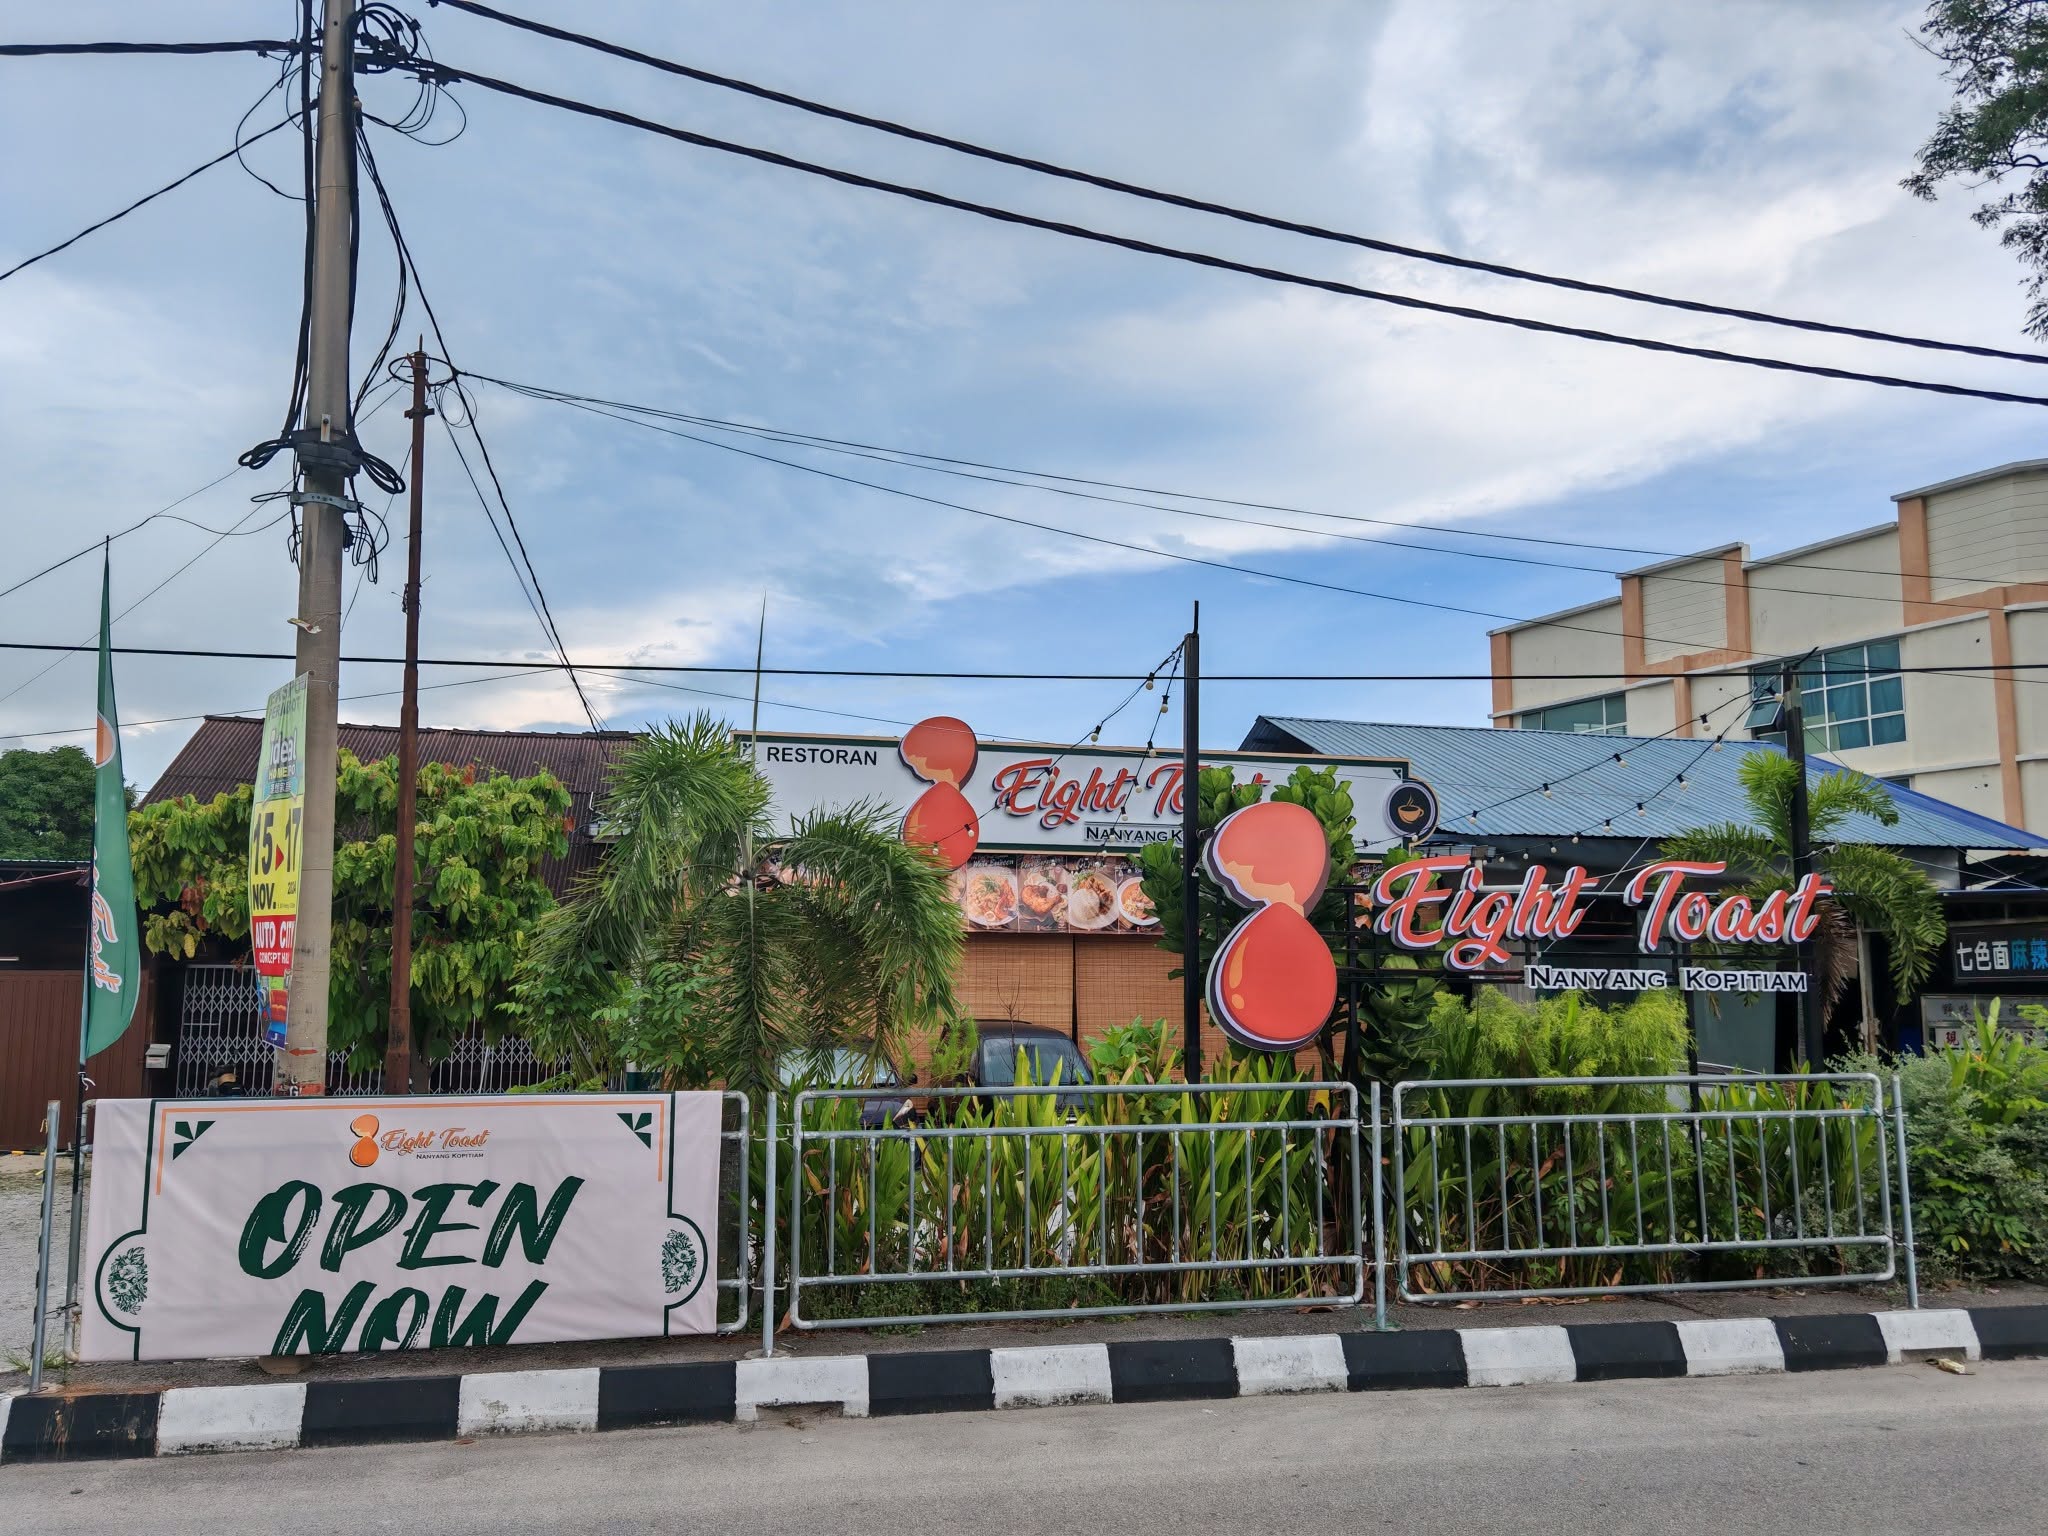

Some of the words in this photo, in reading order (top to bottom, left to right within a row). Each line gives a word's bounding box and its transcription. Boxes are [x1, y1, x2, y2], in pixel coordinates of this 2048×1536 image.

[767, 746, 877, 766] RESTORAN
[992, 758, 1138, 830] Eight
[254, 812, 274, 875] 15
[285, 808, 301, 873] 17
[1086, 826, 1168, 842] NANYANG
[252, 883, 276, 911] NOV.
[1369, 854, 1600, 971] Eight
[1623, 861, 1834, 954] Toast
[255, 921, 276, 949] AUTO
[1529, 966, 1666, 989] NANYANG
[1685, 969, 1806, 992] KOPITIAM
[380, 1129, 436, 1156] Eight
[439, 1127, 491, 1150] Toast
[238, 1176, 585, 1280] OPEN
[270, 1281, 549, 1357] NOW
